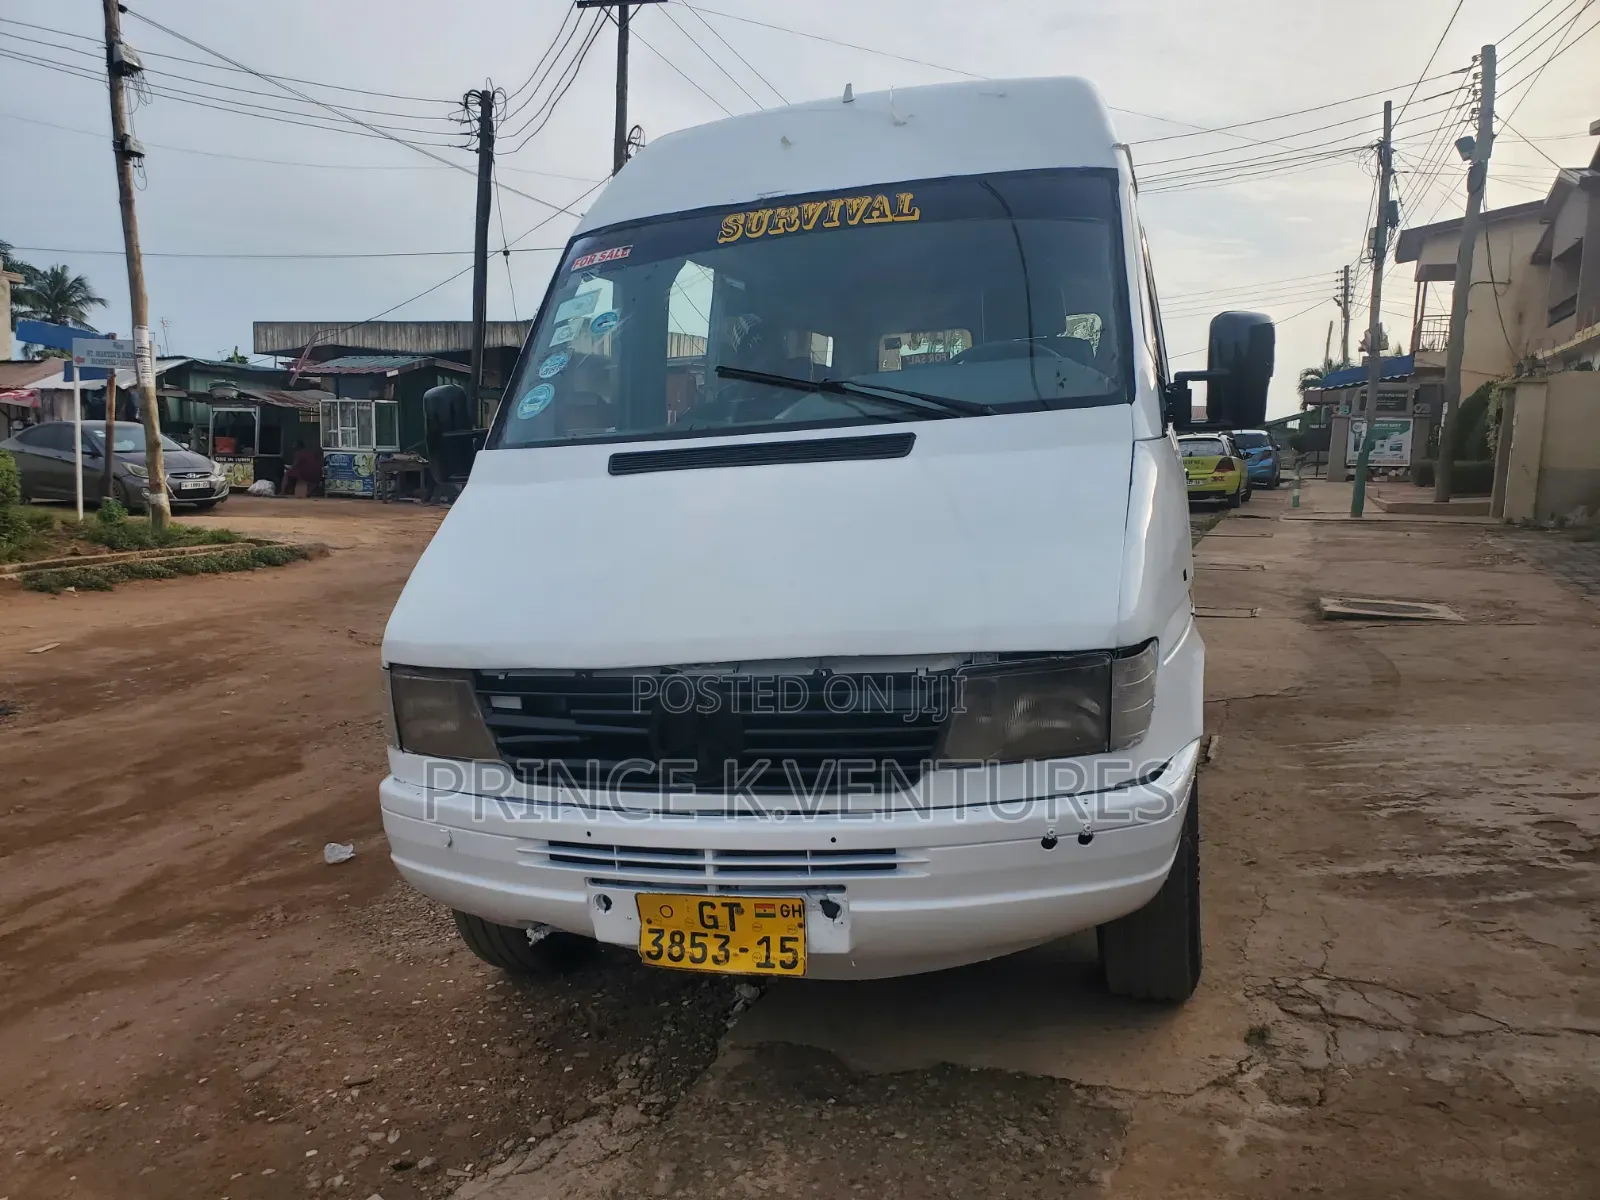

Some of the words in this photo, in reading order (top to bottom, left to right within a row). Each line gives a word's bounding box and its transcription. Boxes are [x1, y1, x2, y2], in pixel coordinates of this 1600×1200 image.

[717, 192, 920, 244] SURVIVAL
[572, 254, 596, 270] FOR
[599, 246, 631, 263] SALE
[698, 900, 741, 932] GT
[780, 903, 802, 918] GH
[645, 928, 799, 970] 3853-15
